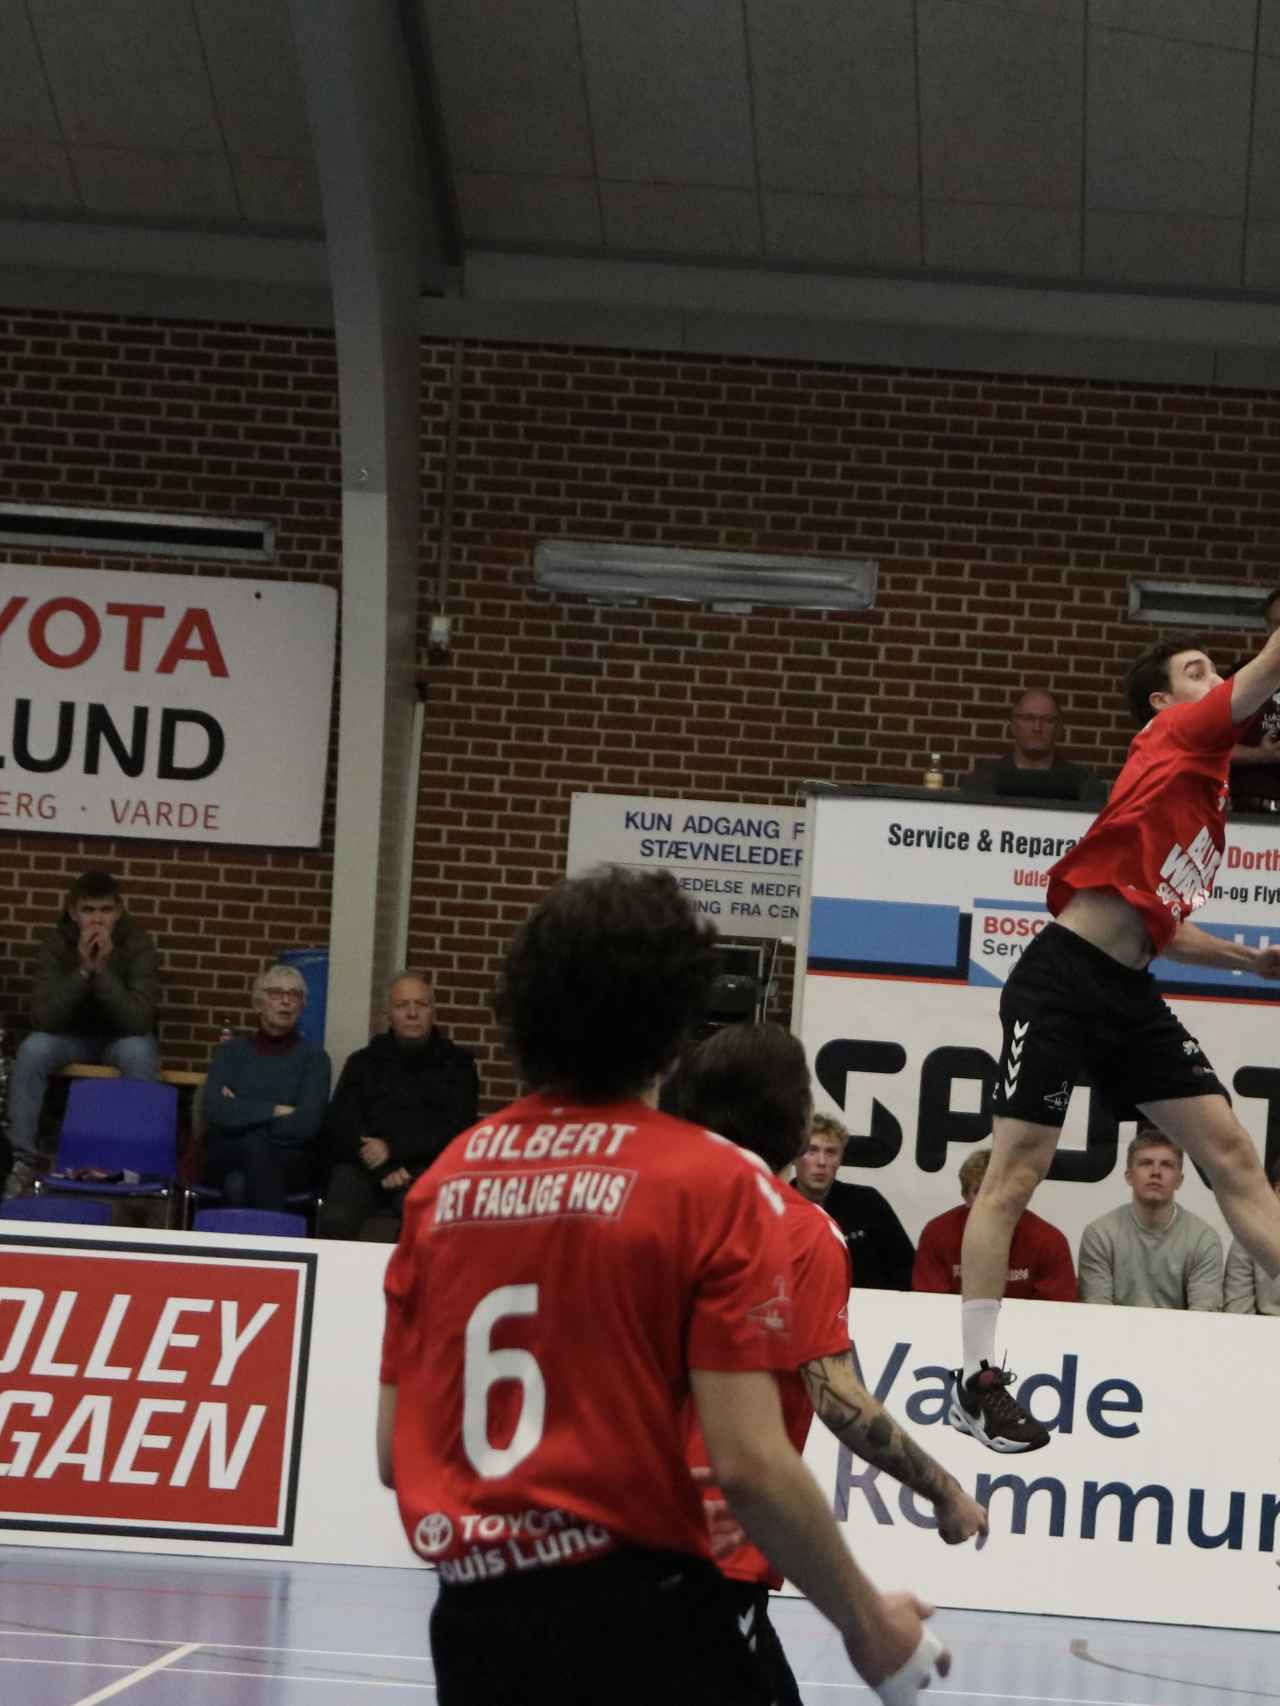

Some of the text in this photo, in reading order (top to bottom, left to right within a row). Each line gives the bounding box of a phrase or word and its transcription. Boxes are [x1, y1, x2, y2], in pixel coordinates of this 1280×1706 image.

[0, 698, 225, 780] UND
[110, 798, 220, 830] VARDE
[624, 811, 672, 832] KUN
[682, 815, 780, 839] ADGANG
[888, 823, 969, 850] Service
[977, 829, 993, 852] &
[731, 901, 761, 917] FRA
[1209, 883, 1248, 903] n-og
[464, 1122, 638, 1162] GILBERT
[473, 1172, 569, 1218] FAGLIGE
[567, 1170, 627, 1214] HUS
[463, 1283, 546, 1481] 6
[849, 1339, 1144, 1438] Vade
